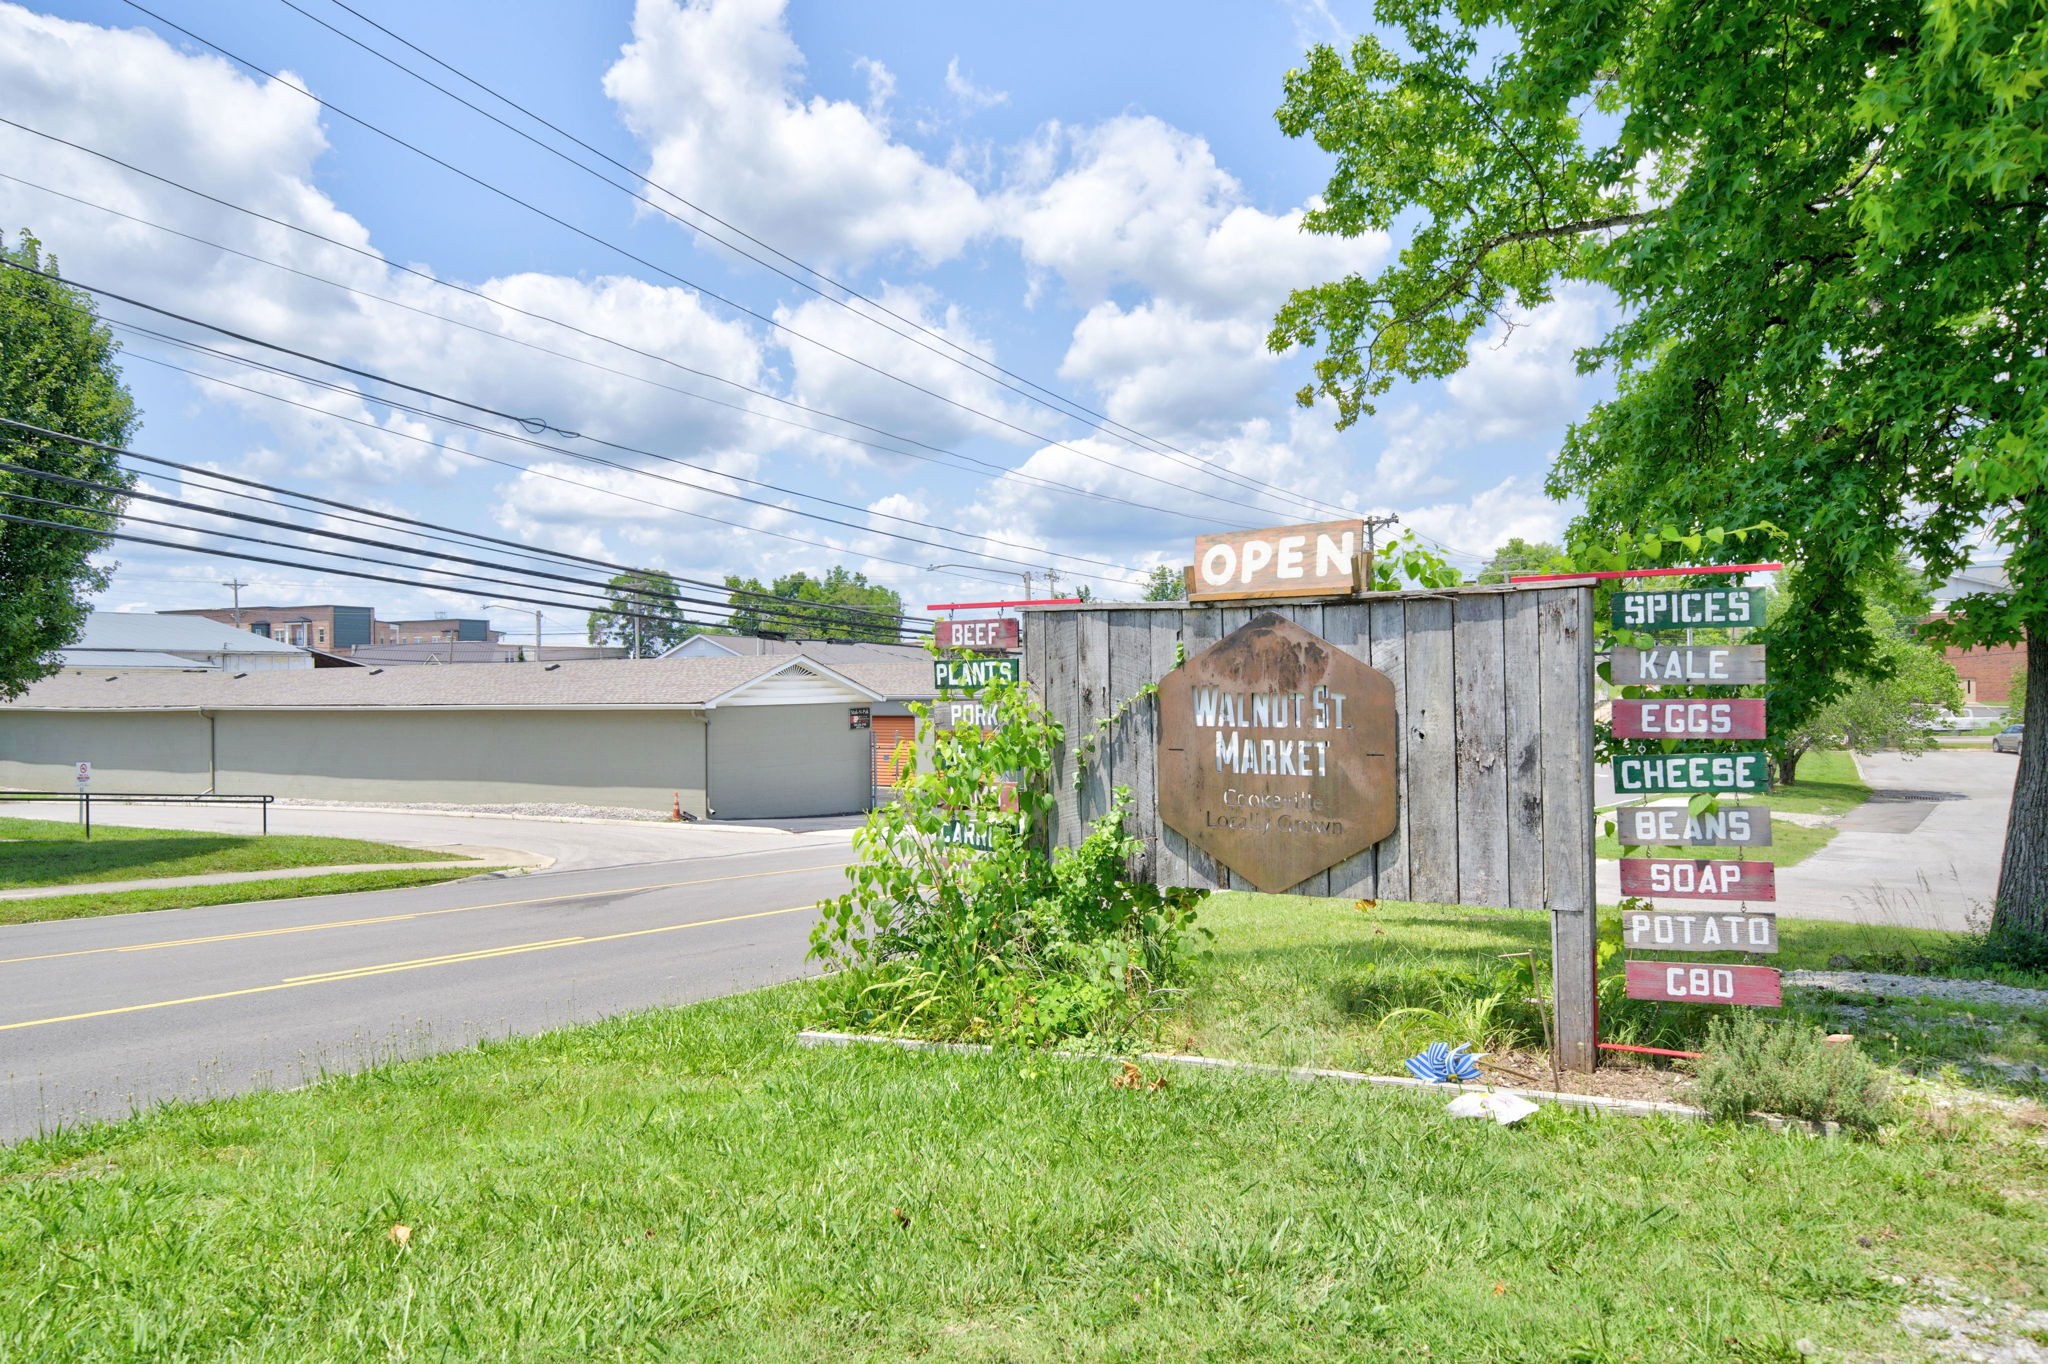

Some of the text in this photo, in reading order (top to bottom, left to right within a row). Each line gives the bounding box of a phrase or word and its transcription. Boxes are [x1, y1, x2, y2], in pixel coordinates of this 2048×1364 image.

[1201, 531, 1355, 587] OPEN
[1624, 591, 1751, 625] SPICES
[951, 622, 1000, 647] BEEF
[935, 661, 1012, 686] PLANTS
[1639, 650, 1730, 680] KALE
[950, 703, 999, 727] PORK
[1191, 684, 1306, 729] WALNUT
[1641, 703, 1732, 734] EGGS
[1215, 730, 1331, 777] MARKET
[1620, 755, 1756, 790] CHEESE
[1222, 788, 1324, 811] Cookeille
[1634, 810, 1752, 842] BEANS
[1650, 863, 1742, 894] SOAP
[1631, 914, 1770, 945] POTATO
[1666, 967, 1735, 999] CBD
